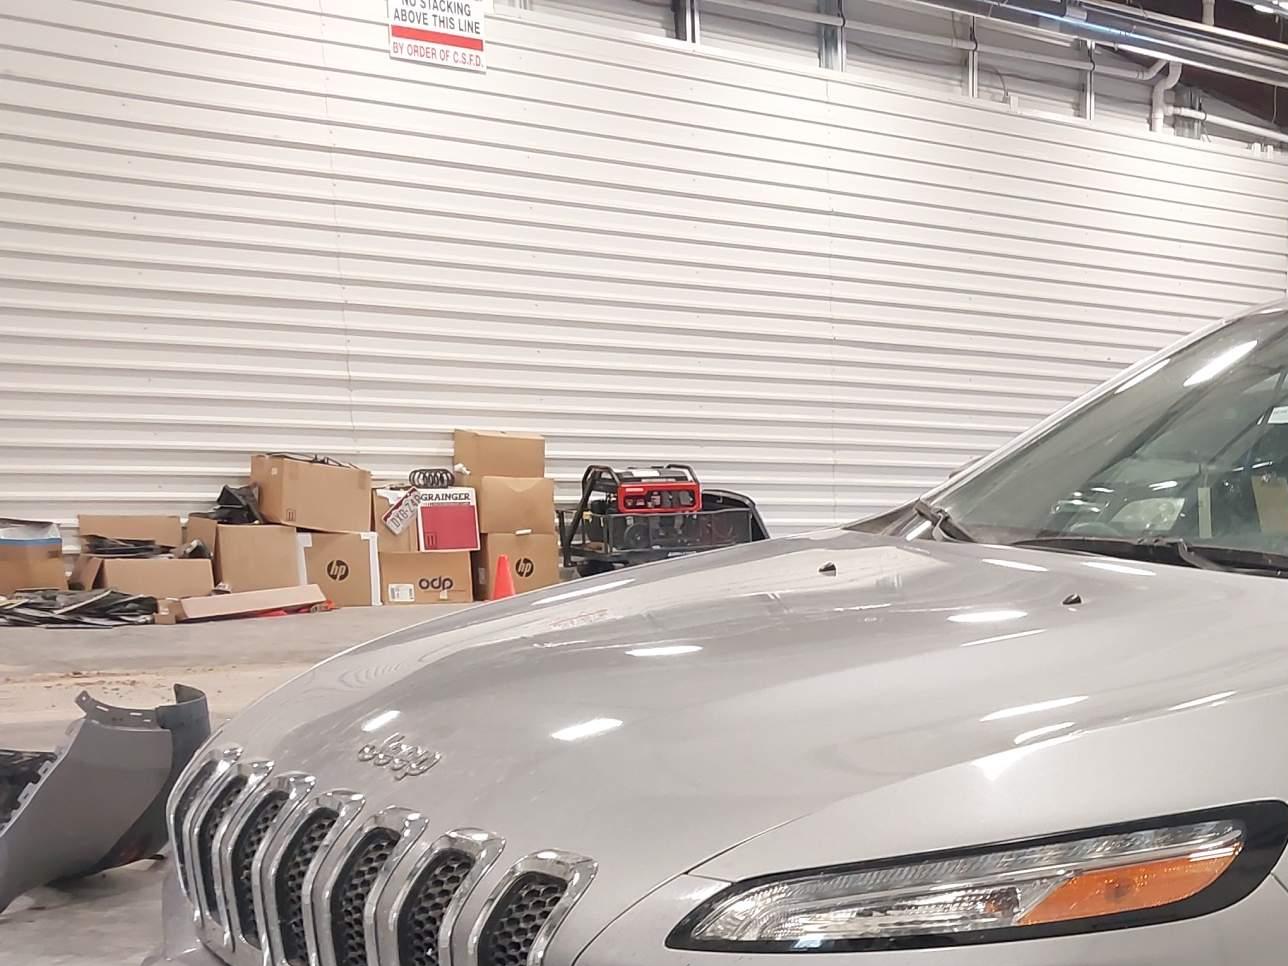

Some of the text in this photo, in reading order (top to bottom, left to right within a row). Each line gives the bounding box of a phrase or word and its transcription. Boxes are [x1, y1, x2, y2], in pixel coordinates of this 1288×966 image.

[420, 0, 471, 17] STACKING
[394, 8, 480, 34] ABOVE THIS LINE
[393, 41, 404, 55] BY
[407, 44, 437, 62] ORDER
[440, 49, 450, 61] OF
[420, 493, 470, 501] GRAINGER
[329, 560, 347, 580] hp
[419, 576, 453, 590] odp
[358, 733, 441, 781] Jeep
